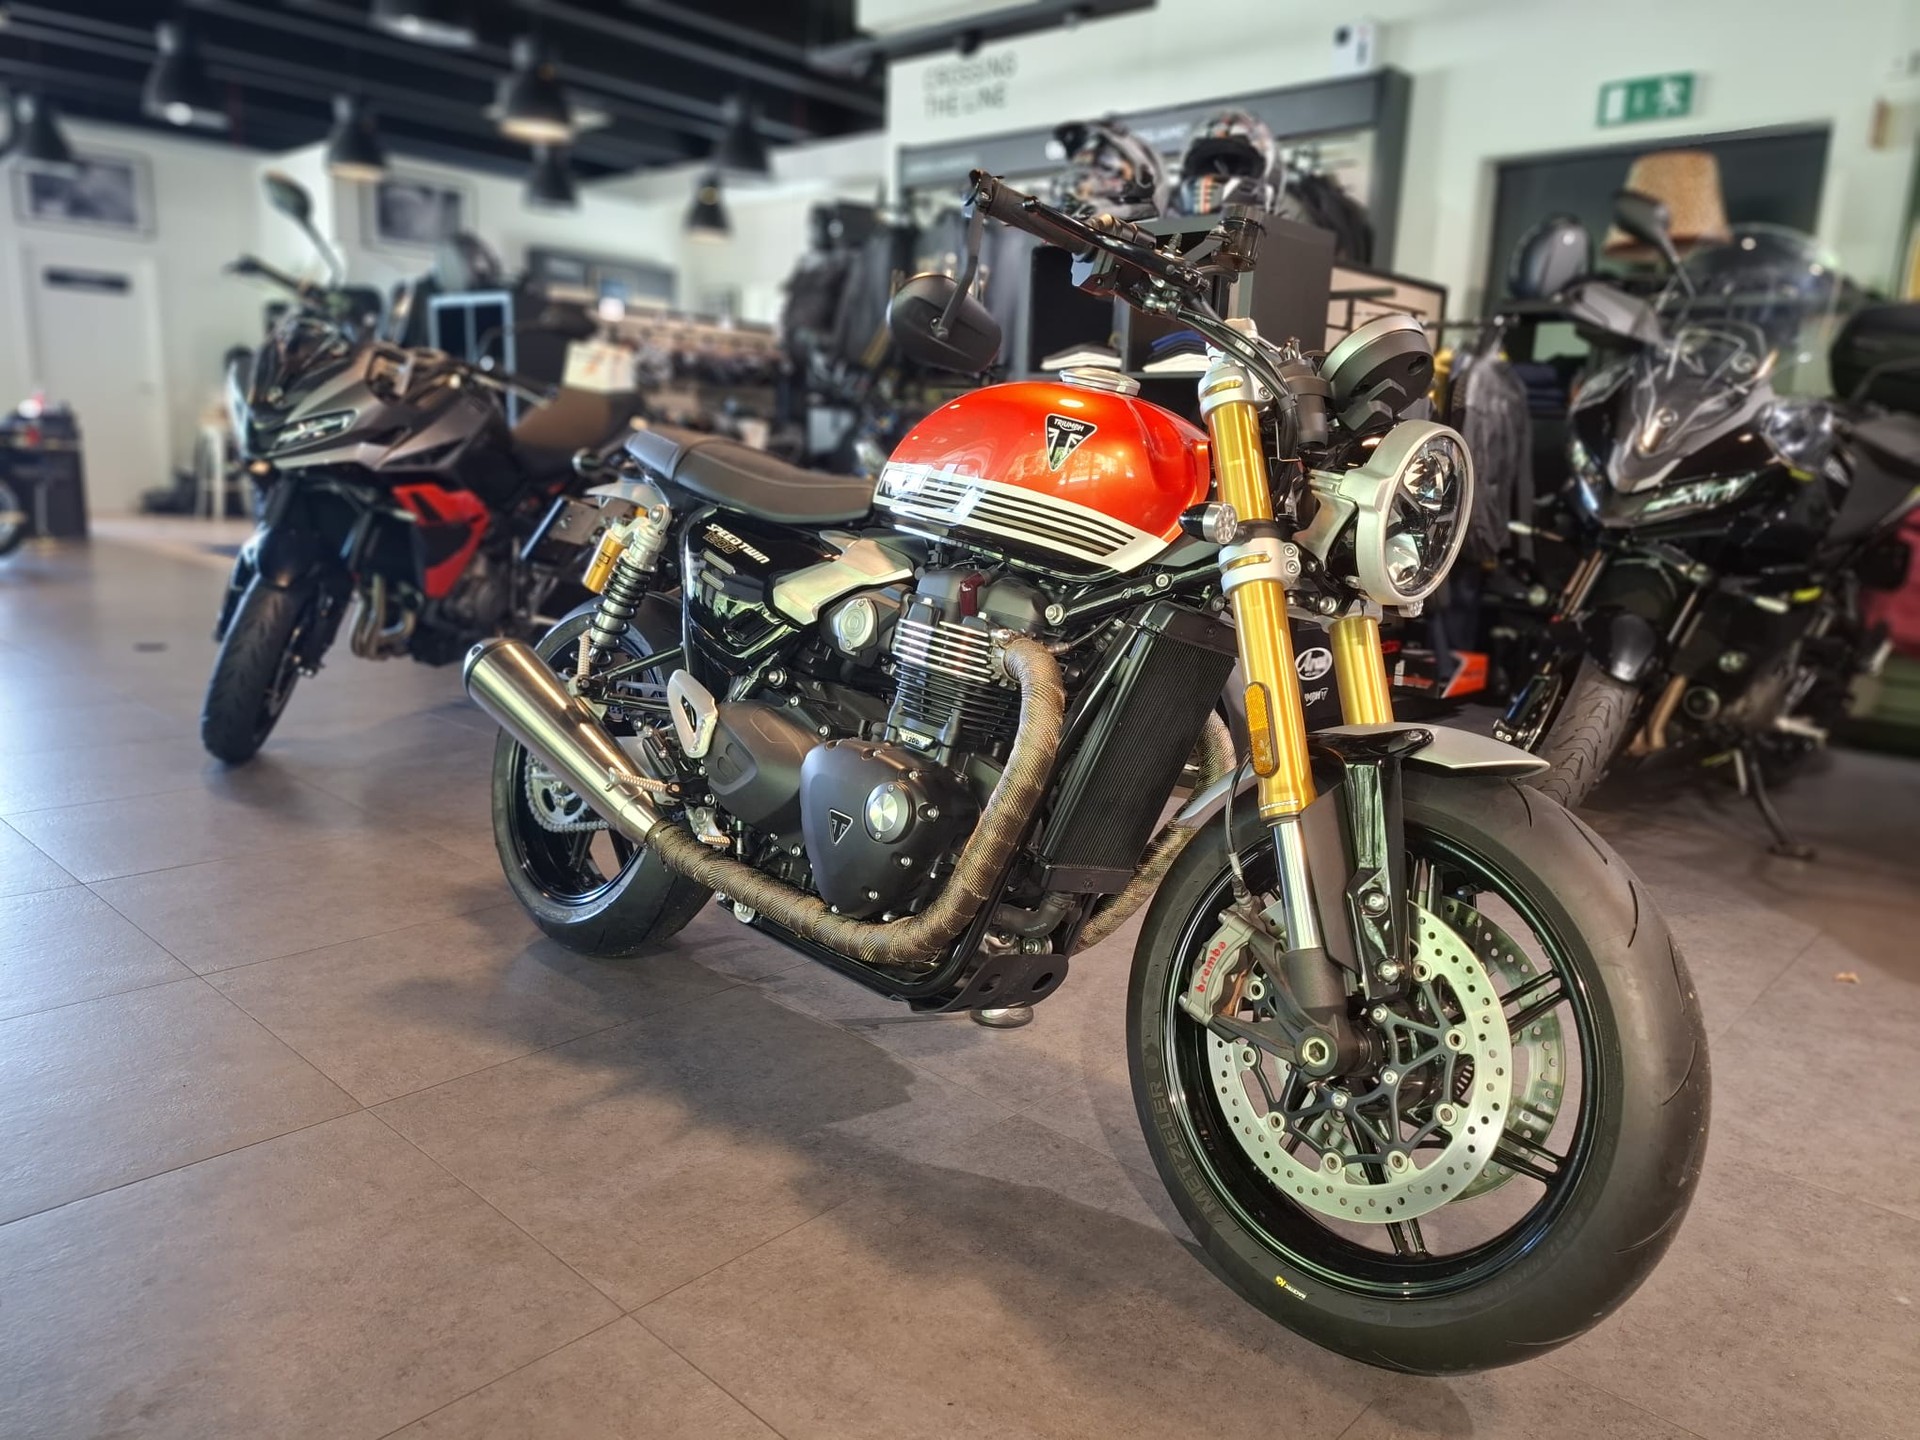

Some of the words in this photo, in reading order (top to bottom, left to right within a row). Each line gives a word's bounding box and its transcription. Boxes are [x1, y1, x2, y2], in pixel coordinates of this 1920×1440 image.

[923, 92, 960, 119] THE
[961, 81, 1007, 115] LINE
[1054, 418, 1085, 432] TRIUMPH
[702, 530, 738, 554] 1200
[705, 523, 742, 545] SPEED
[738, 542, 770, 564] TWIN
[1195, 941, 1226, 993] brembo
[1150, 1080, 1216, 1215] METZELER
